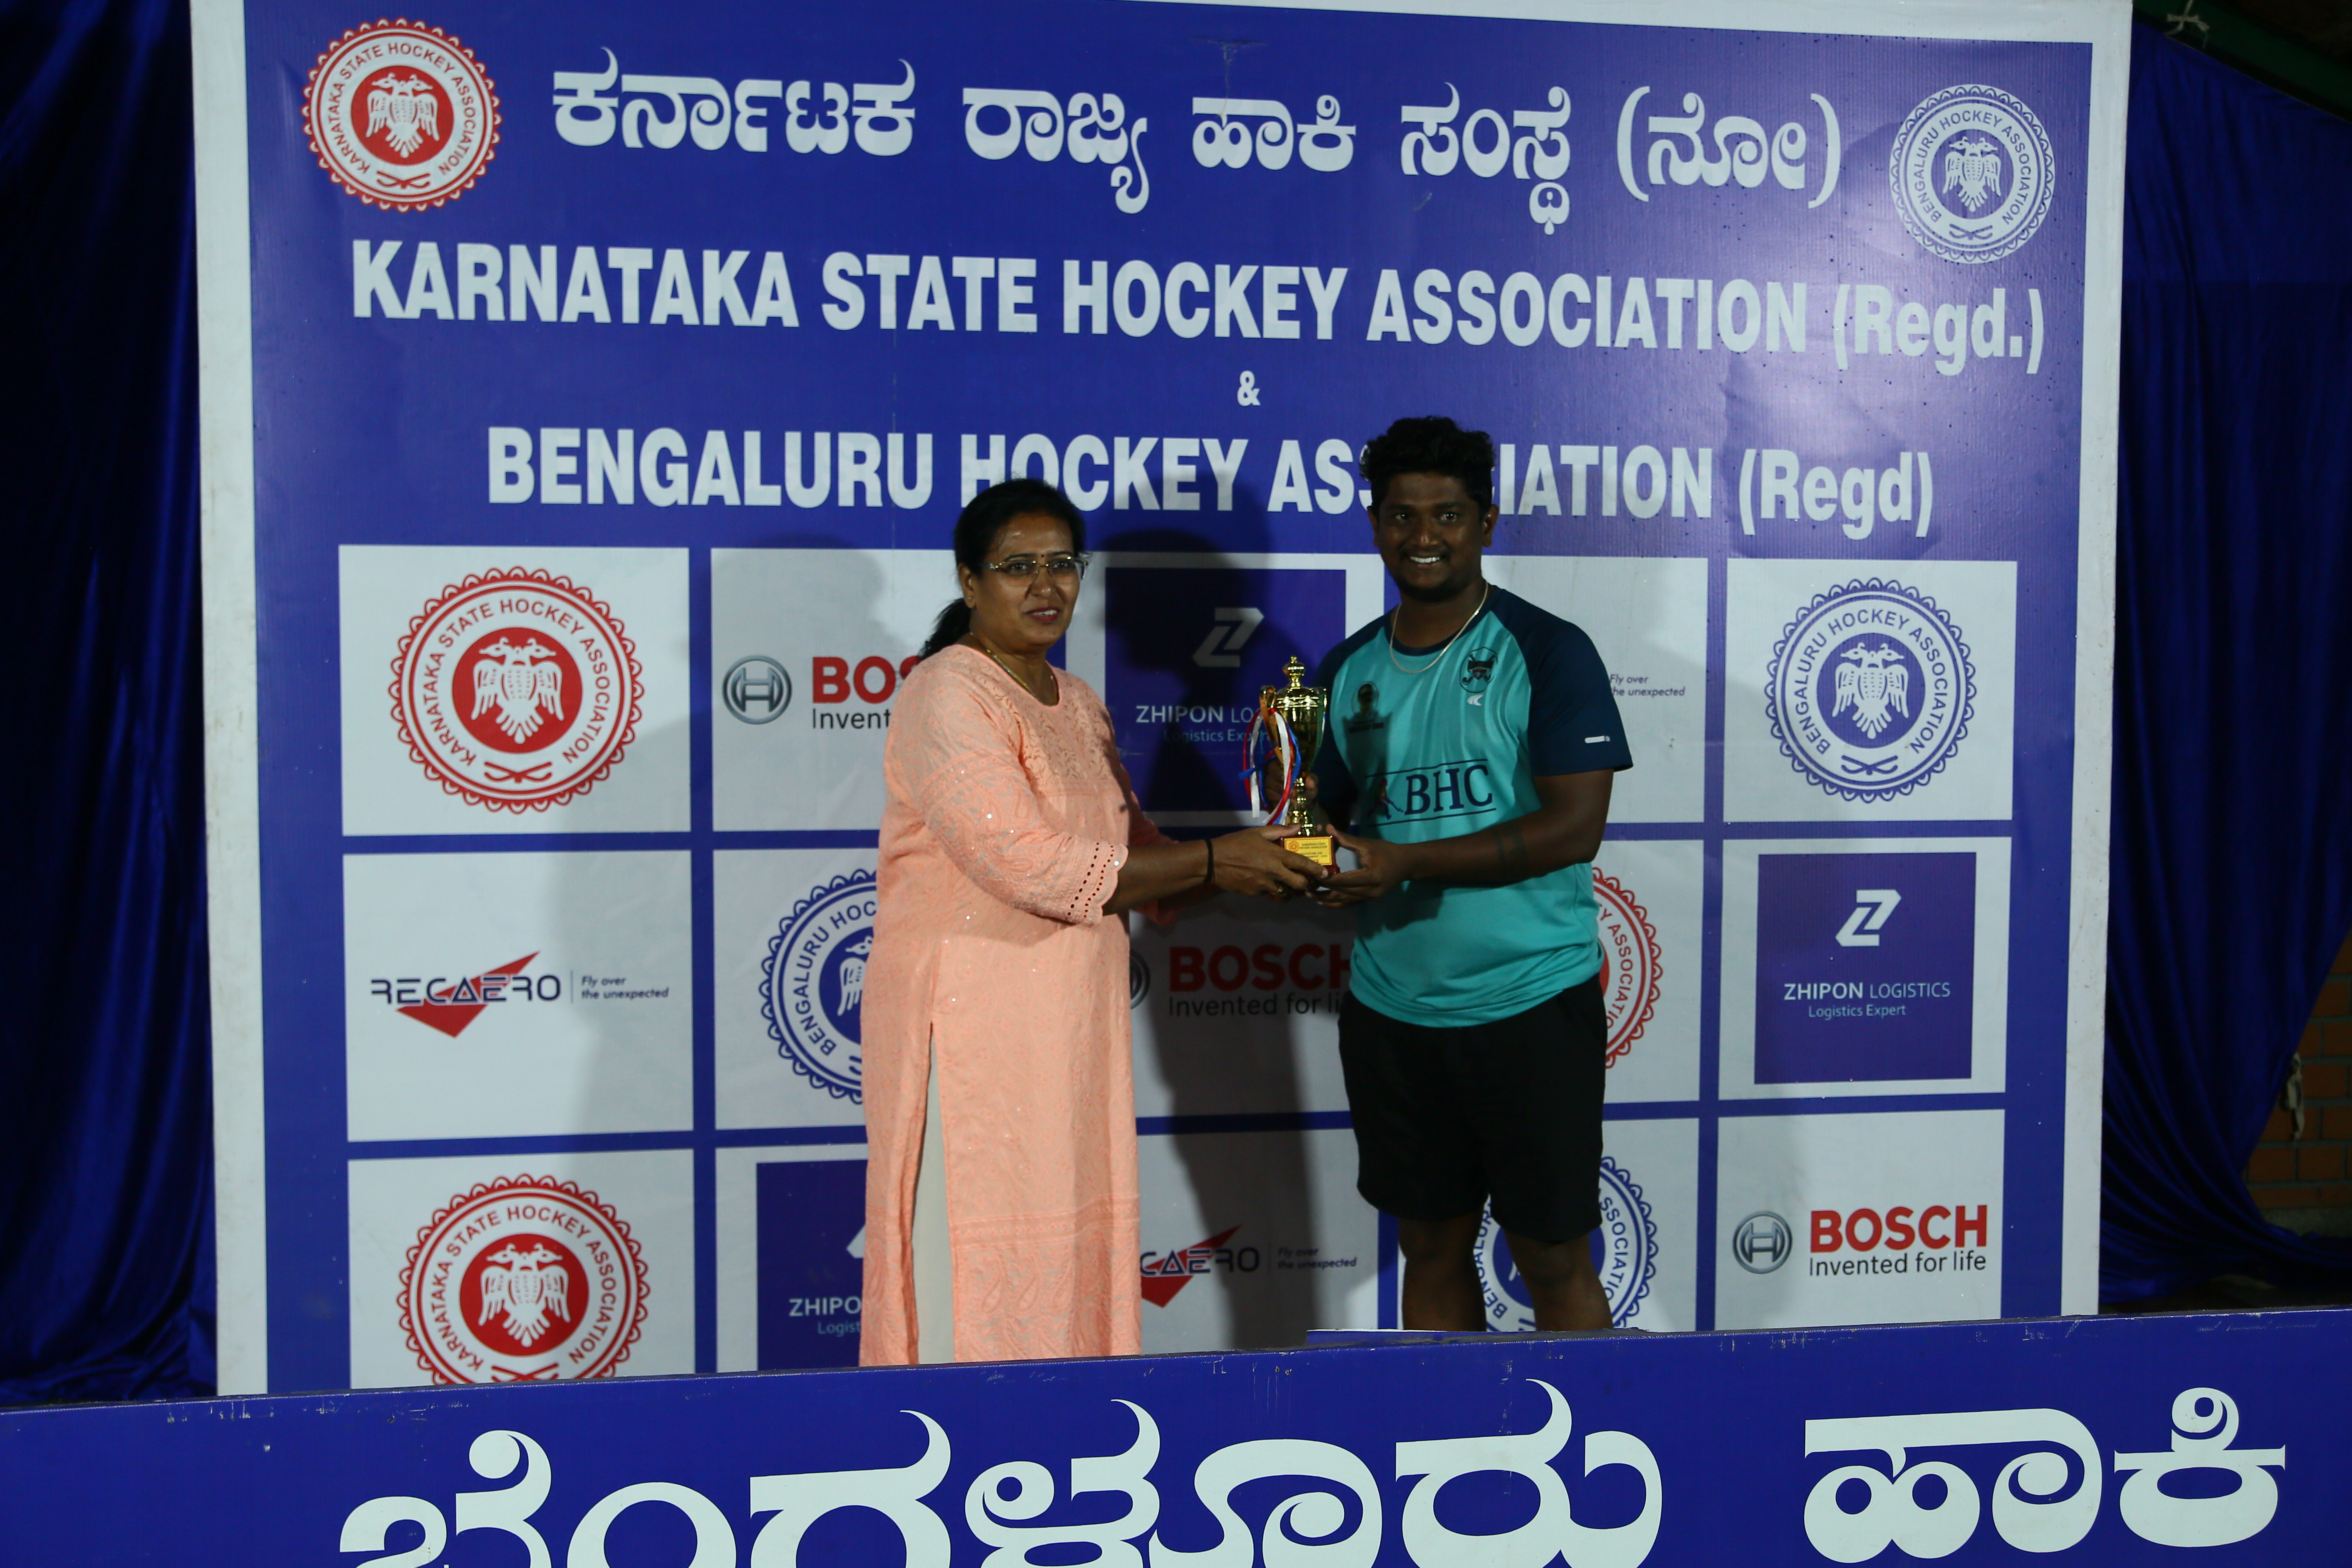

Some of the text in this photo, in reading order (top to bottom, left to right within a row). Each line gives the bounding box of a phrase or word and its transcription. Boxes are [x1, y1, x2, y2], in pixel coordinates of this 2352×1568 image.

[329, 42, 477, 176] KARNATAKA STATE HOCKEY ASSOCIATION
[553, 46, 1842, 235] ಕರ್ನಾಟಕ ರಾಜ್ಯ ಹಾಕಿ ಸಂಸ್ಥೆ (ನೋ)
[1913, 110, 2031, 225] BENGALURU HOCKEY ASSOCIATION
[352, 239, 2044, 376] KARNATAKA STATE HOCKEY ASSOCIATION (Regd.)
[1236, 370, 1261, 406] &
[488, 425, 1933, 540] BENGALURU HOCKEY ASIATION (Regd)
[423, 599, 611, 766] KARNATAKA STATE HOCKEY ASSOCIATION
[1610, 674, 1649, 686] Fly over
[1611, 686, 1686, 698] he unexpected
[1794, 608, 1948, 755] BENGALURU HOCKEY ASSOCIATION
[812, 708, 890, 729] Invent
[1136, 705, 1224, 724] ZHIPON
[1163, 728, 1224, 744] Logistics
[1405, 764, 1492, 816] BHC
[371, 974, 561, 1004] RECAERO
[581, 975, 626, 988] Fly over
[793, 901, 877, 1056] BENGALURU HOC
[1606, 924, 1633, 1029] ASSOCIATIO
[581, 986, 670, 1000] the unexpected
[1169, 993, 1277, 1017] Invented
[1287, 992, 1321, 1014] for
[1784, 982, 1951, 1001] ZHIPON LOGISTICS
[1808, 1003, 1907, 1021] Logistics Expert
[1810, 1204, 1988, 1254] BOSCH
[1140, 1247, 1260, 1275] CAERO
[1296, 1248, 1319, 1257] over
[1297, 1257, 1357, 1270] unexpected
[1810, 1250, 1987, 1277] Invented for life
[431, 1205, 617, 1372] KARNATAKA STATE HOCKEY ASSOCIATION
[788, 1295, 862, 1317] ZHIPO
[817, 1320, 861, 1337] Logist
[1803, 1387, 2286, 1564] ಹಾಕಿ
